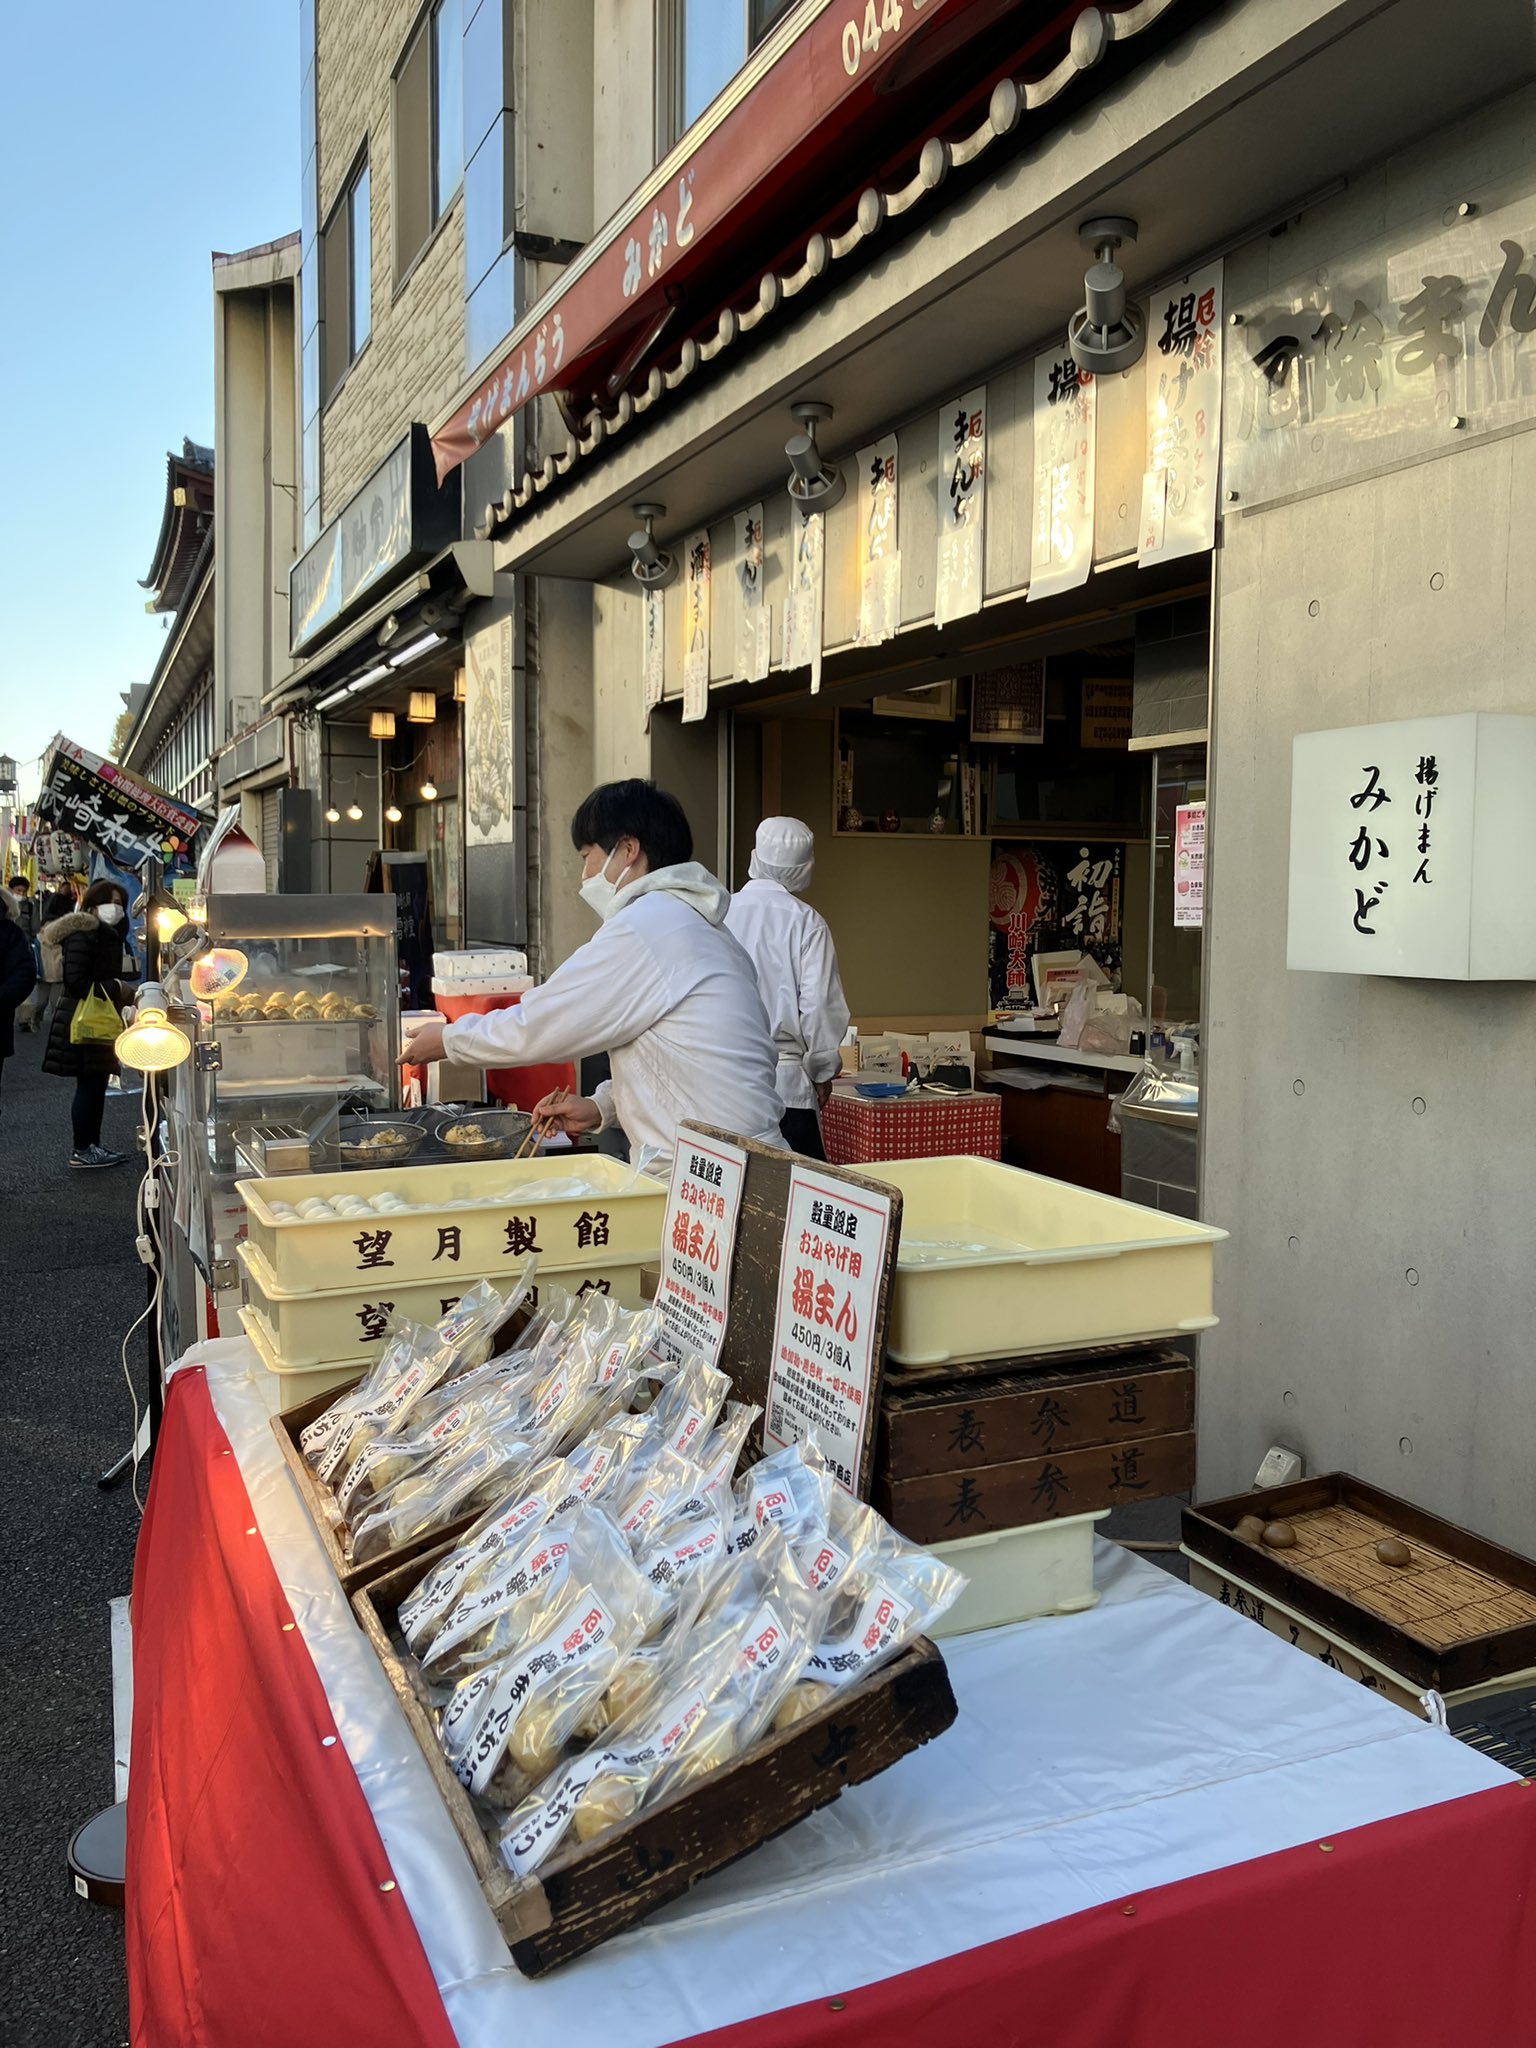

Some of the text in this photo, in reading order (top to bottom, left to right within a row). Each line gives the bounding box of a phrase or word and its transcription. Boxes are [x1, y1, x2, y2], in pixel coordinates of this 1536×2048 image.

[622, 168, 697, 298] みかど
[42, 770, 165, 870] 長崎和牛
[1349, 765, 1392, 936] みかど
[1413, 756, 1440, 885] 揚げまん
[1062, 847, 1114, 941] 初詣
[1006, 912, 1028, 988] 川崎大師
[680, 1179, 725, 1221] おみやげ用
[810, 1200, 859, 1240] 数量限定
[352, 1210, 611, 1271] 望月製餡
[671, 1210, 721, 1273] 揚まん
[799, 1229, 863, 1280] おみやげ用
[792, 1266, 859, 1343] 揚まん
[791, 1322, 852, 1373] 450円/3個入
[946, 1382, 1147, 1454] 表参道
[944, 1447, 1151, 1528] 表参道
[561, 1607, 603, 1654] 厄除
